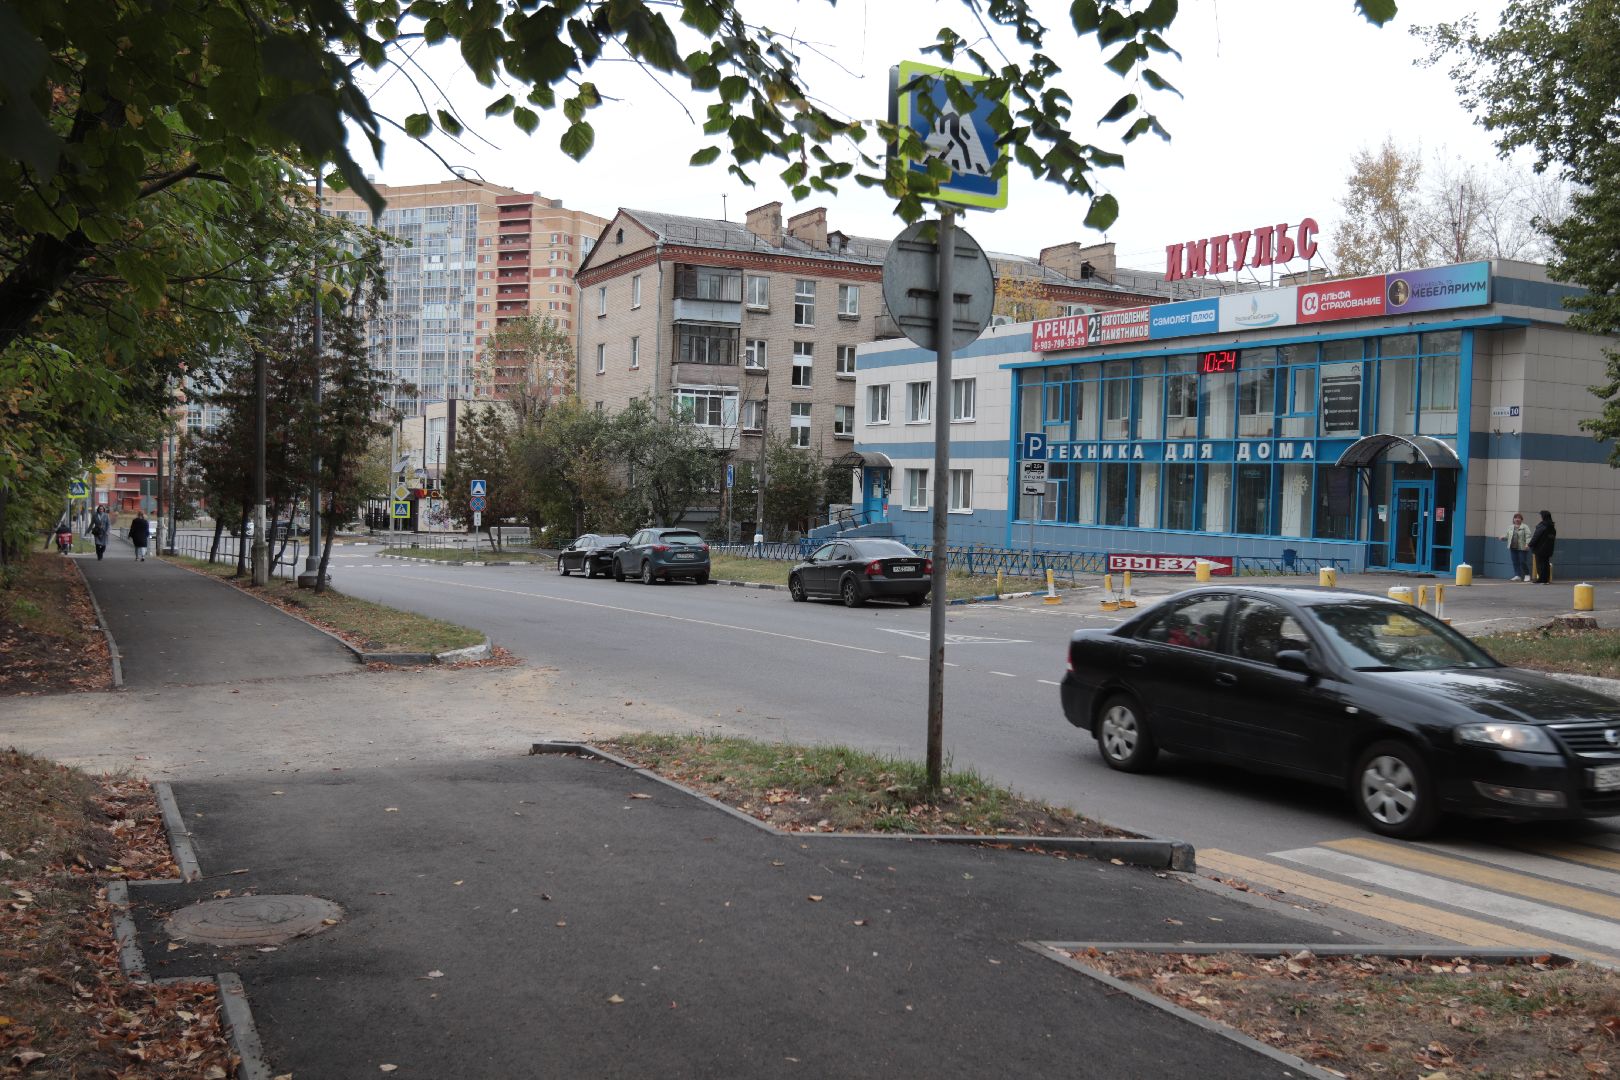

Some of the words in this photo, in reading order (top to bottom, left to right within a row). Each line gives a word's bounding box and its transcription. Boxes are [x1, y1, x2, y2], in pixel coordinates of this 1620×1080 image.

[1164, 217, 1319, 282] ИМПУЛЬС
[1320, 290, 1351, 302] АЛЬФА
[1411, 280, 1486, 299] МЕБЕЛЯРИУМ
[1320, 296, 1381, 311] СТРАХОВАНИЕ
[1101, 309, 1149, 326] ИЗГОТОВЛЕНИЕ
[1153, 314, 1191, 327] самолет
[1036, 318, 1084, 339] АРЕНДА
[1088, 316, 1097, 343] 2
[1101, 324, 1149, 341] ПАМЯТНИКОВ
[1203, 351, 1237, 373] 10:24
[1510, 407, 1519, 416] 10
[1047, 443, 1144, 460] ТЕХНИКА
[1165, 443, 1213, 461] ДЛЯ
[1237, 442, 1314, 461] ДОМА
